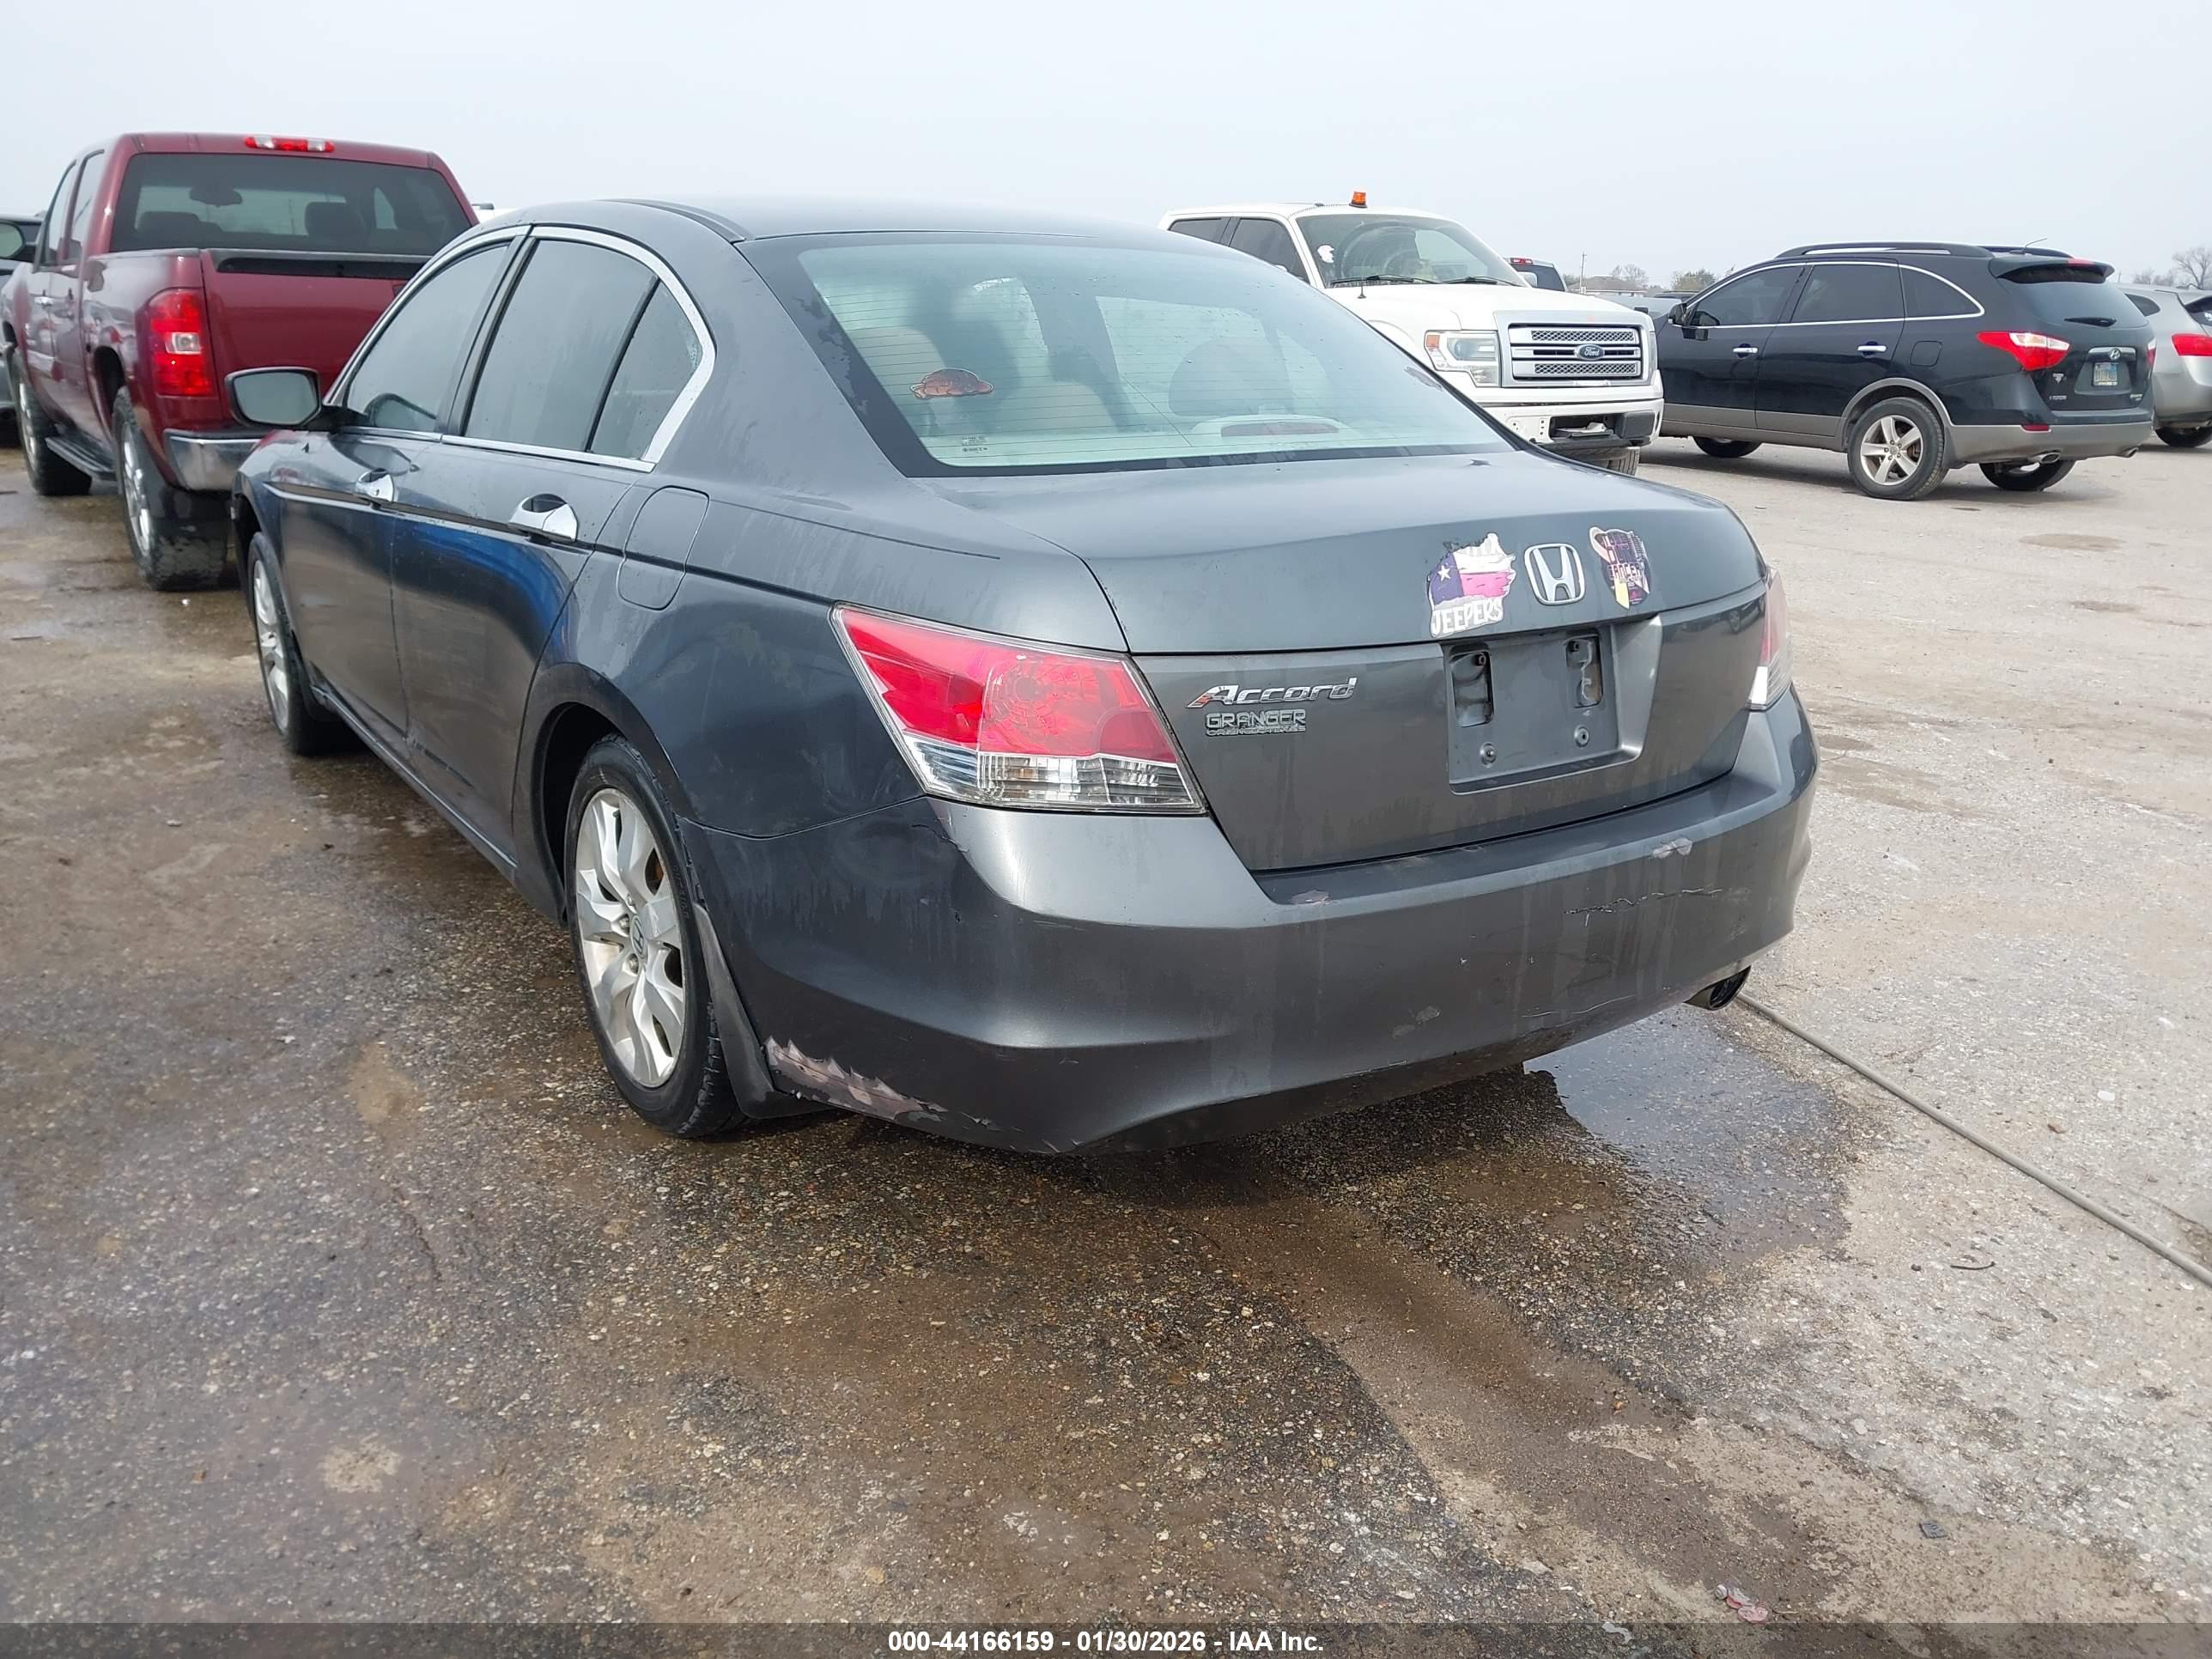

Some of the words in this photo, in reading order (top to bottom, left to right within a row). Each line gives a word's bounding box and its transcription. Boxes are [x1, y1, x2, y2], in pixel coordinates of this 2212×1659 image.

[1583, 346, 1601, 357] Ford
[1431, 599, 1504, 635] JEEPERS
[1187, 677, 1358, 708] Accord
[1206, 708, 1306, 729] GRANGER
